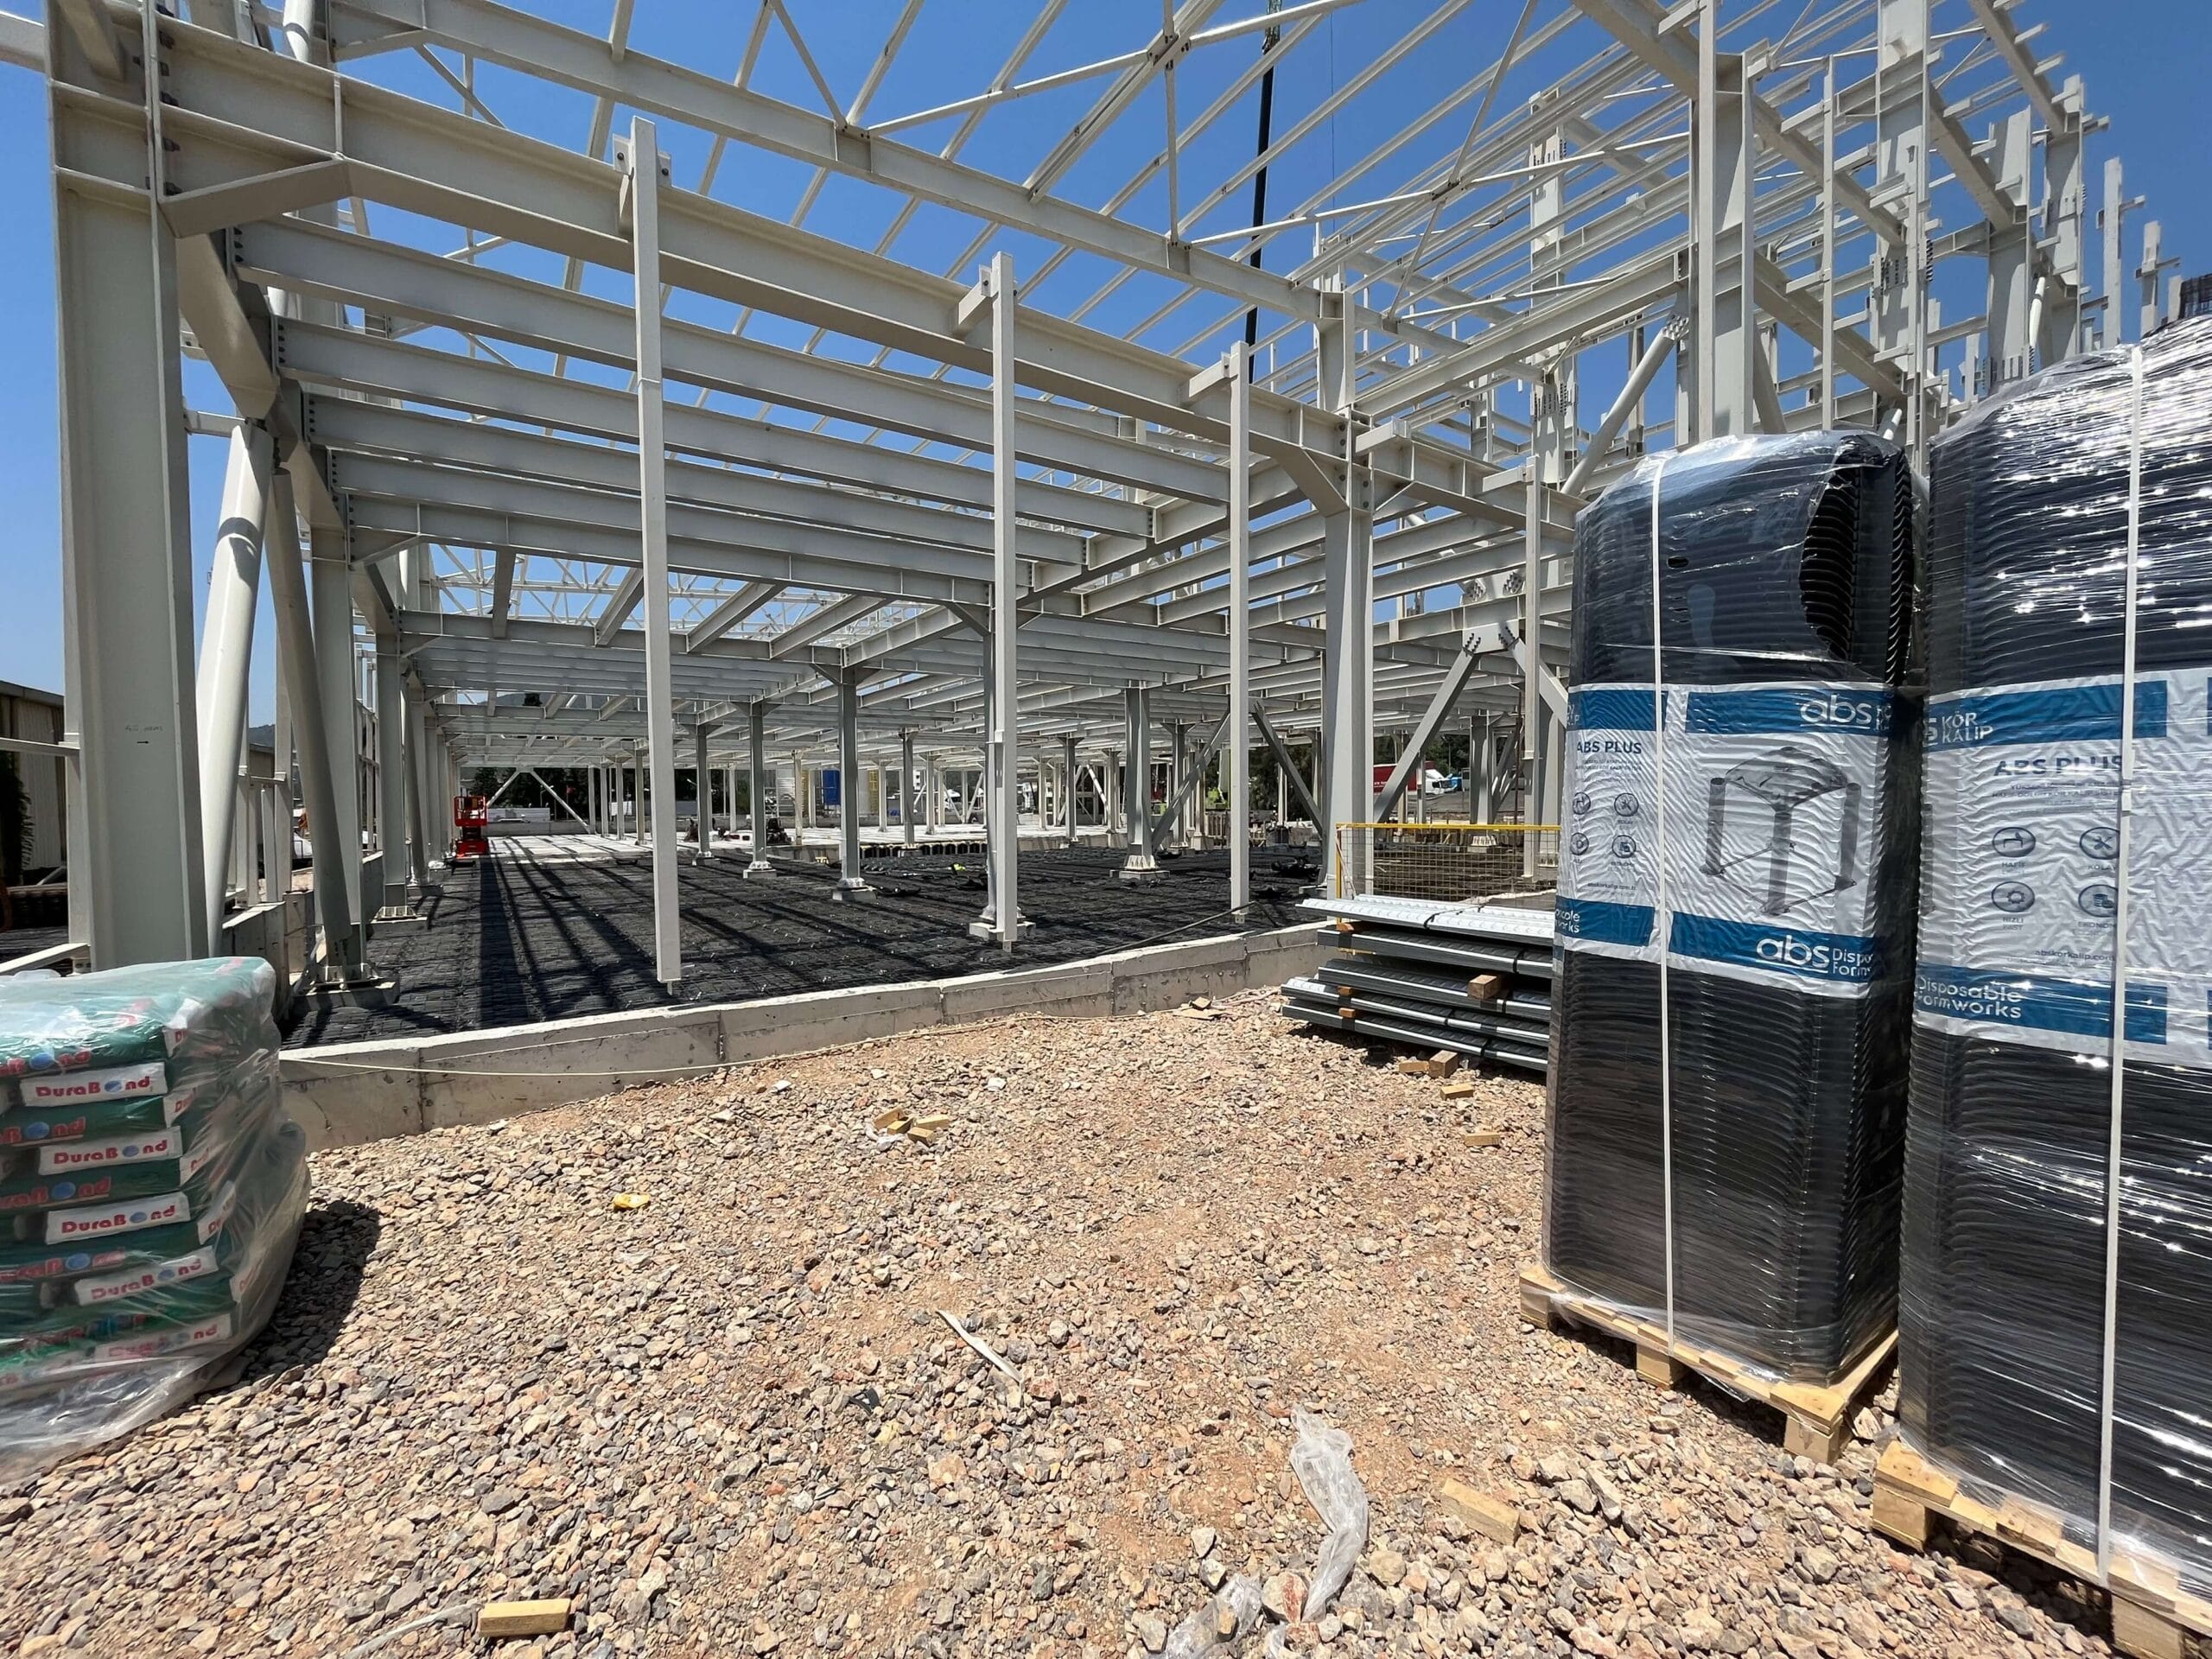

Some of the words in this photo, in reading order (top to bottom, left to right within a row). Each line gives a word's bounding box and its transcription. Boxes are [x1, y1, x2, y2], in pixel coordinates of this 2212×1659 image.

[1800, 693, 1872, 724] abs
[1942, 725, 1994, 744] KALIP
[1577, 741, 1600, 753] ABS
[1605, 741, 1642, 754] PLUS
[1756, 934, 1830, 969] abs
